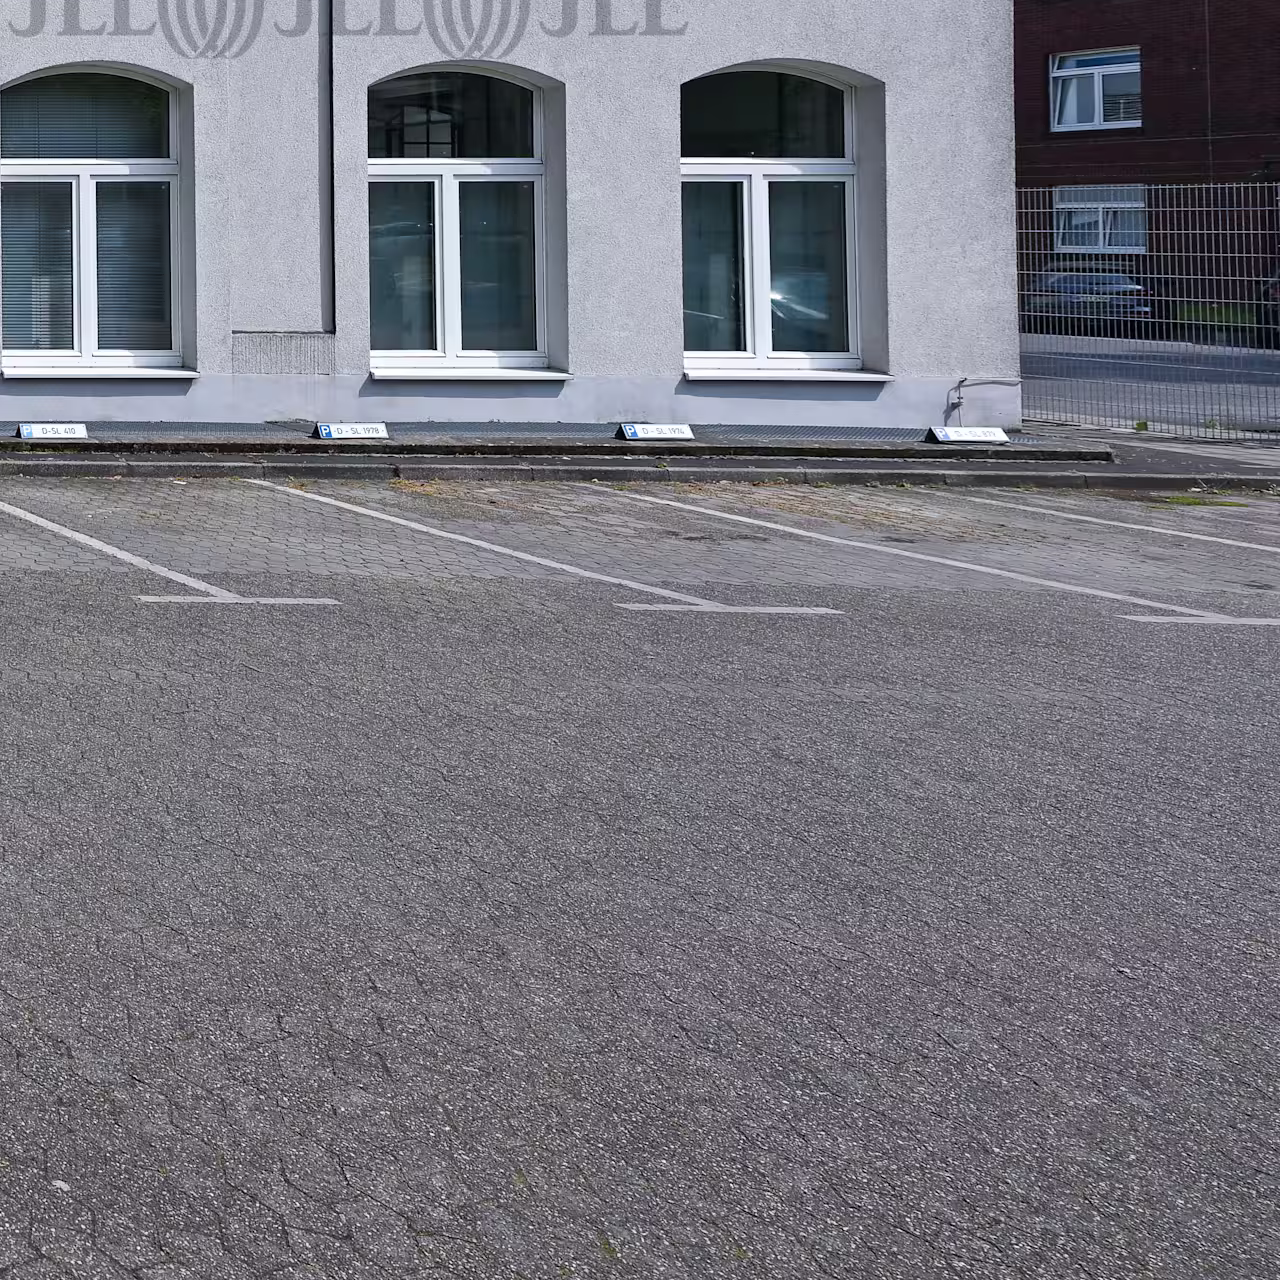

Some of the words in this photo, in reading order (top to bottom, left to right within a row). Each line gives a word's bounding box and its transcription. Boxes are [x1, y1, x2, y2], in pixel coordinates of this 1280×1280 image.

[63, 427, 76, 435] 410
[320, 425, 330, 437] P
[625, 425, 635, 437] P
